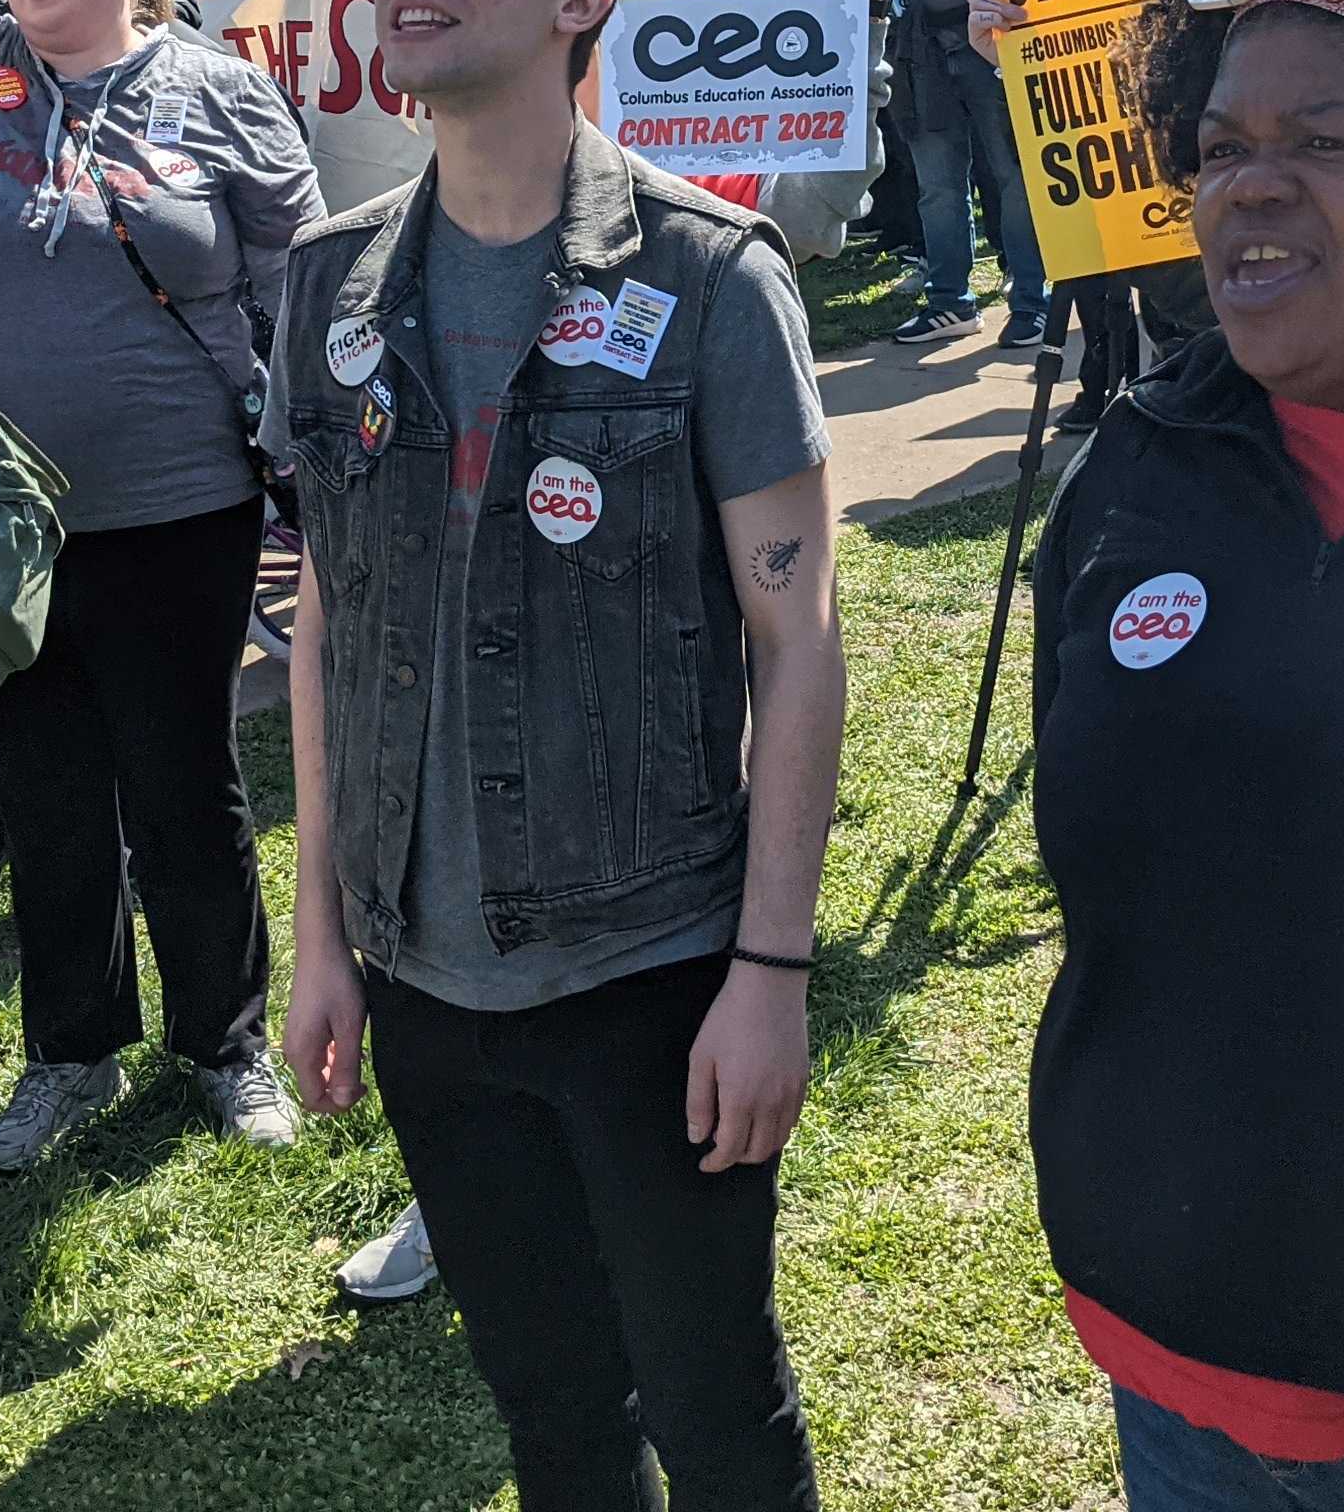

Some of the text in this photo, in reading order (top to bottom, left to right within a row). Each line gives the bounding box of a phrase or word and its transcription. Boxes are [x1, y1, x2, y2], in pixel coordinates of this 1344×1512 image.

[222, 21, 312, 106] THE
[632, 10, 840, 82] cea
[619, 82, 854, 106] Columbus Education Association
[618, 109, 845, 148] CONTRACT 2022
[328, 319, 379, 358] FIGHT
[332, 334, 380, 371] STIGMA
[543, 476, 595, 493] am the
[529, 489, 597, 522] cea
[1140, 591, 1201, 609] am the
[1113, 611, 1193, 640] cea
